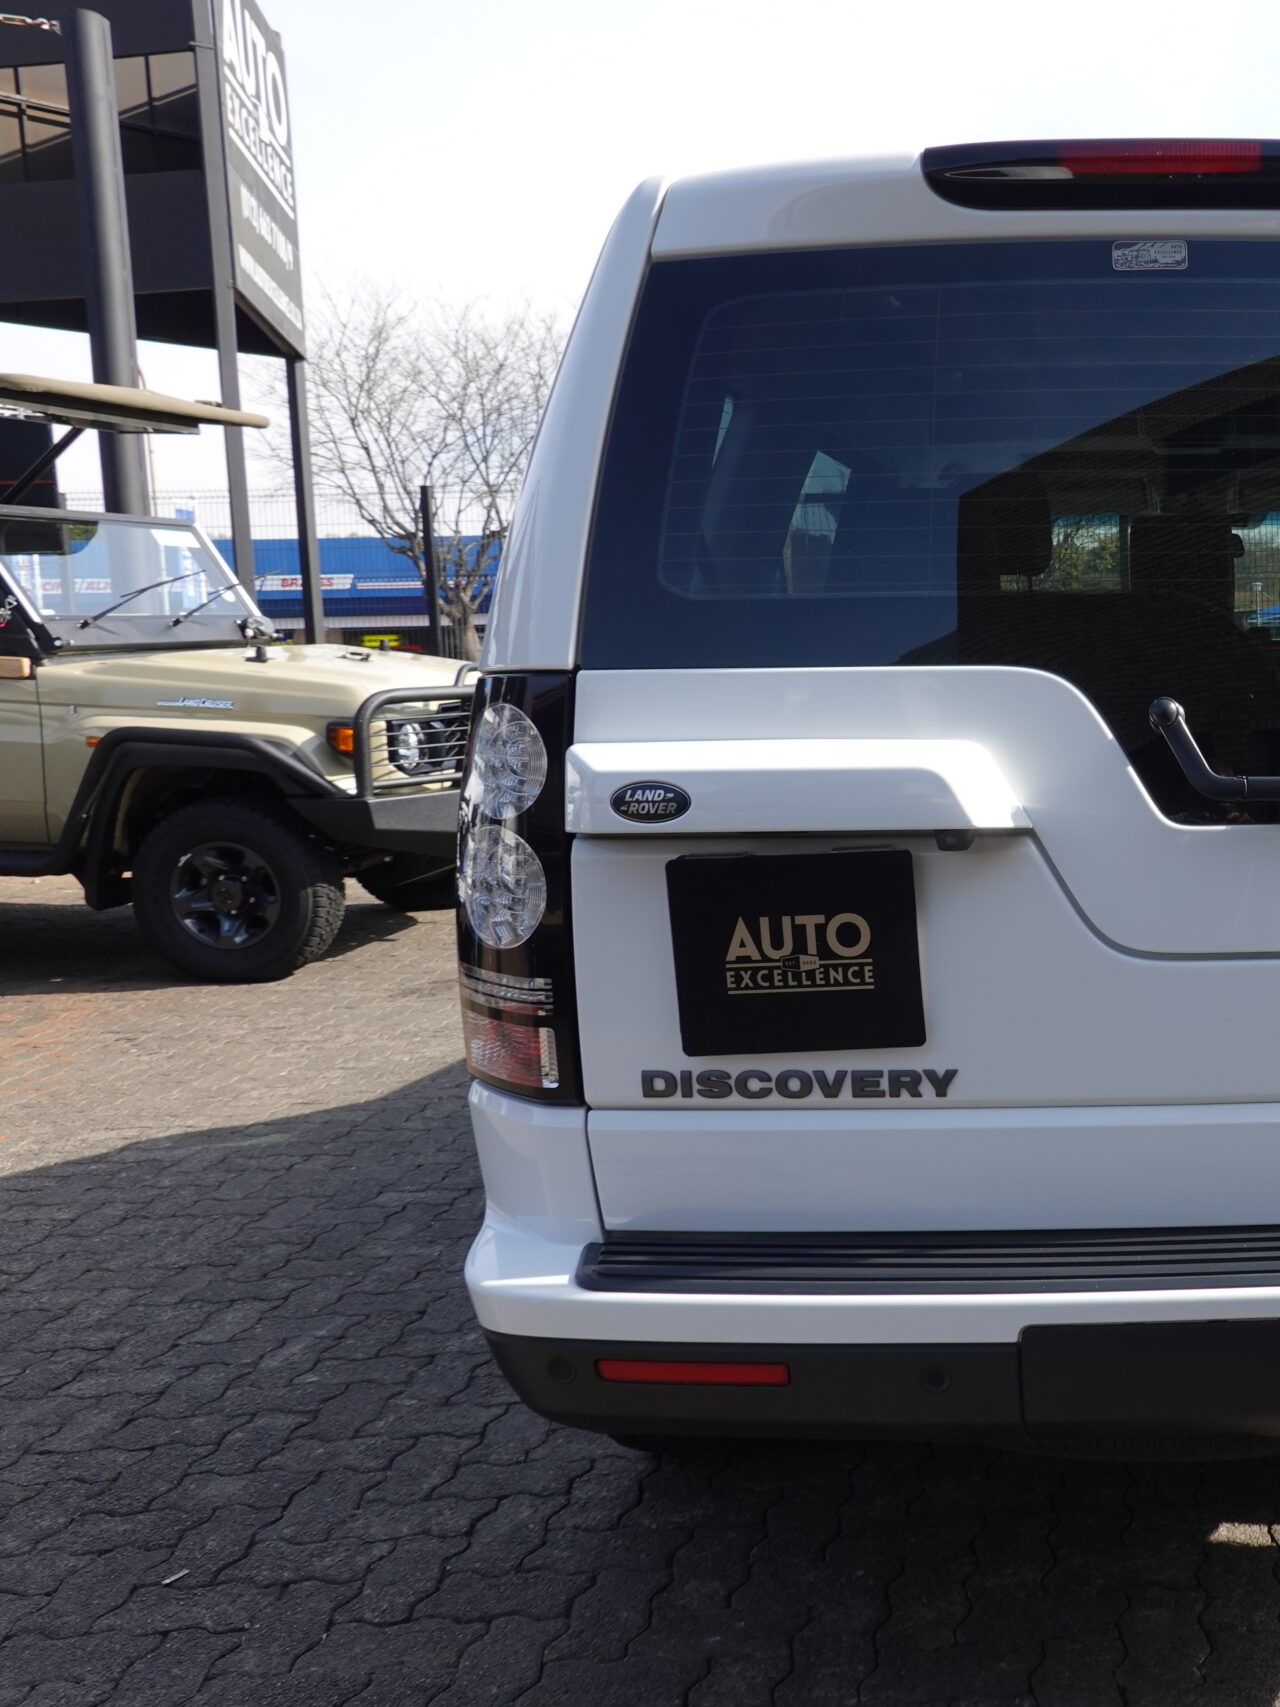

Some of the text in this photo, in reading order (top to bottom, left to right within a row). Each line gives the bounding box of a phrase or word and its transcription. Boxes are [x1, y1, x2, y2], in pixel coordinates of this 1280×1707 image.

[223, 0, 288, 147] AUTO
[624, 789, 665, 801] LAND
[628, 802, 677, 814] ROVER
[725, 912, 871, 961] AUTO
[726, 965, 875, 988] EXCELLENCE
[641, 1068, 959, 1099] DISCOVERY
